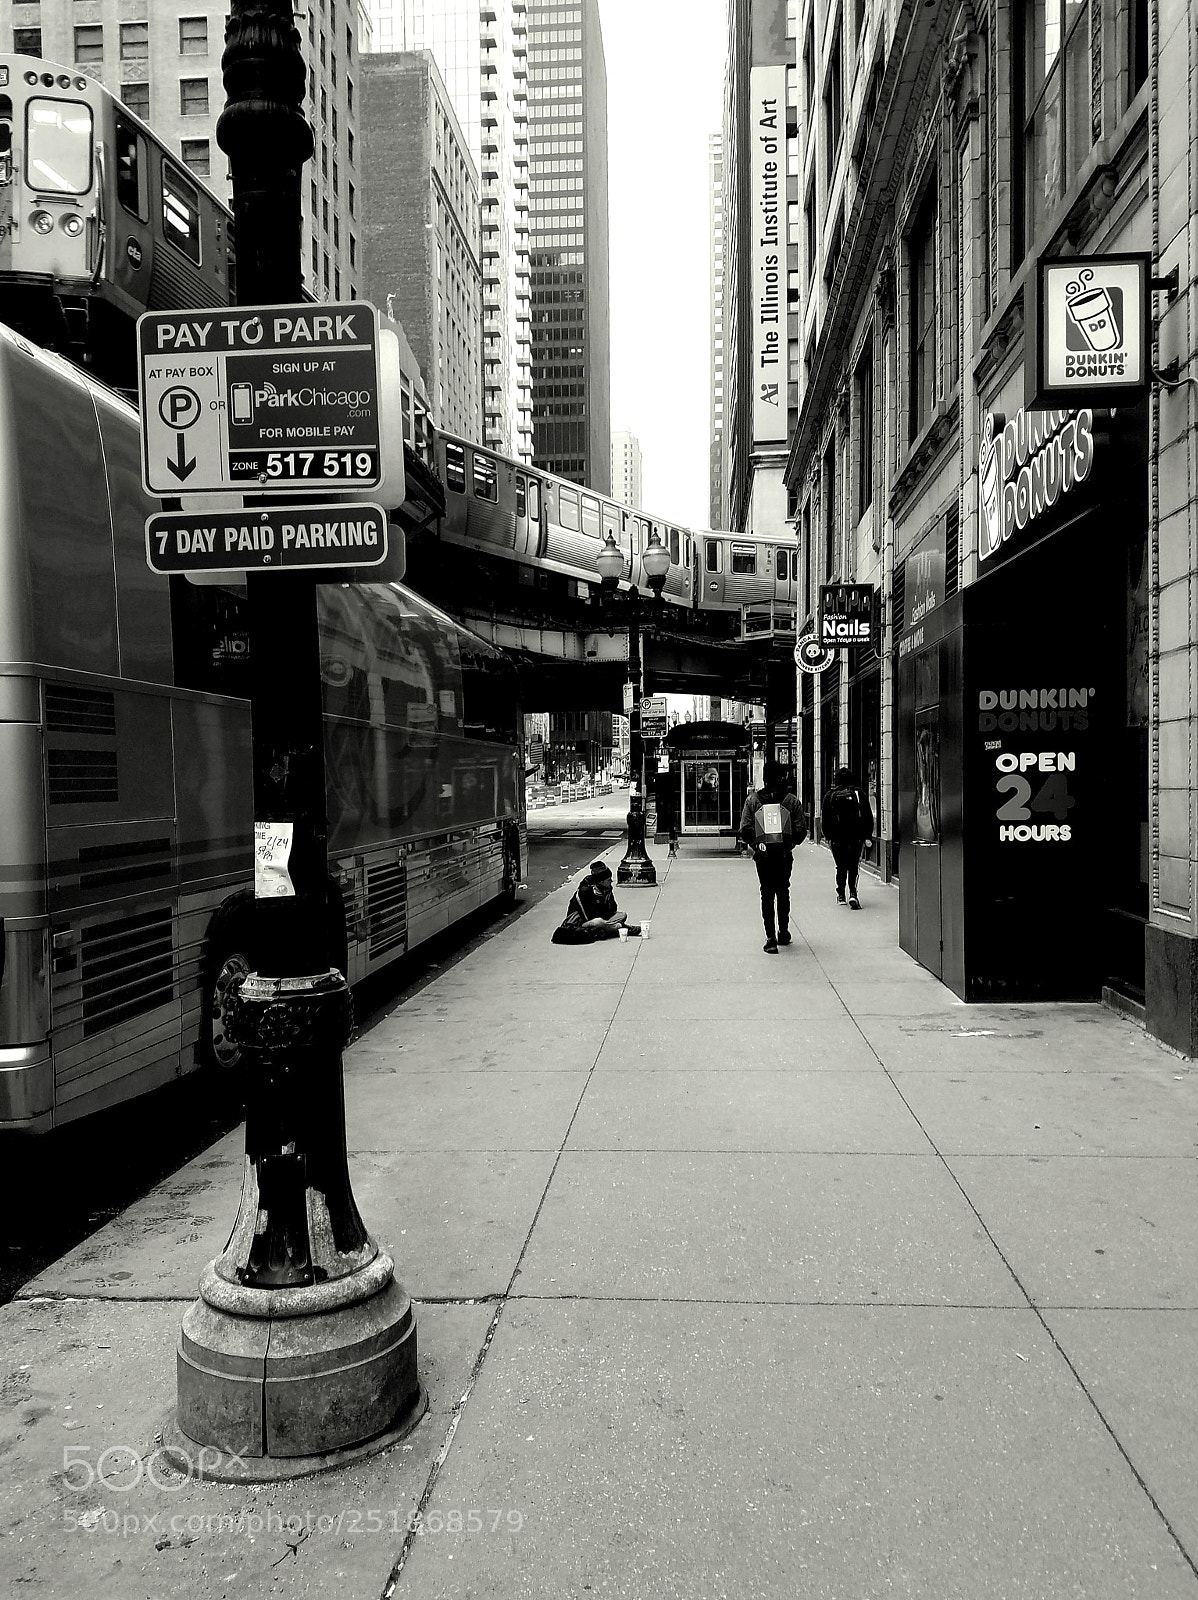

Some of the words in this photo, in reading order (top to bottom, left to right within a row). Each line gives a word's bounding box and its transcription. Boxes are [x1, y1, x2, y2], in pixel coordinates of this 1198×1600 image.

[760, 99, 777, 128] Art
[760, 136, 777, 154] of
[760, 162, 778, 246] Institute
[761, 254, 778, 324] Illinois
[157, 322, 213, 348] PAY
[221, 319, 264, 345] TO
[274, 314, 357, 343] PARK
[1088, 319, 1106, 332] DD
[761, 332, 778, 368] The
[1066, 352, 1128, 366] DUNKIN'
[149, 368, 164, 379] AT
[166, 368, 186, 378] PAY
[190, 366, 214, 377] BOX
[272, 362, 300, 374] SIGN
[303, 362, 318, 373] UP
[320, 362, 336, 372] AT
[1066, 365, 1124, 378] DONUTS
[210, 401, 226, 410] OR
[254, 388, 370, 408] ParkChicago
[346, 408, 370, 418] .com
[259, 428, 282, 438] FOR
[286, 427, 330, 438] MOBILE
[334, 426, 354, 436] PAY
[232, 462, 258, 471] ZONE
[266, 453, 315, 476] 517
[323, 453, 372, 476] 519
[1002, 408, 1094, 542] DONUTS
[155, 531, 168, 554] 7
[176, 528, 217, 554] DAY
[224, 526, 275, 552] PAID
[282, 520, 378, 549] PARKING
[823, 612, 848, 621] Fashion
[822, 618, 870, 637] Nails
[978, 688, 1096, 710] DUNKIN'
[978, 710, 1089, 732] DONUTS
[996, 752, 1076, 772] OPEN
[996, 774, 1076, 820] 24
[1000, 824, 1072, 842] HOURS
[267, 836, 288, 850] 2/24
